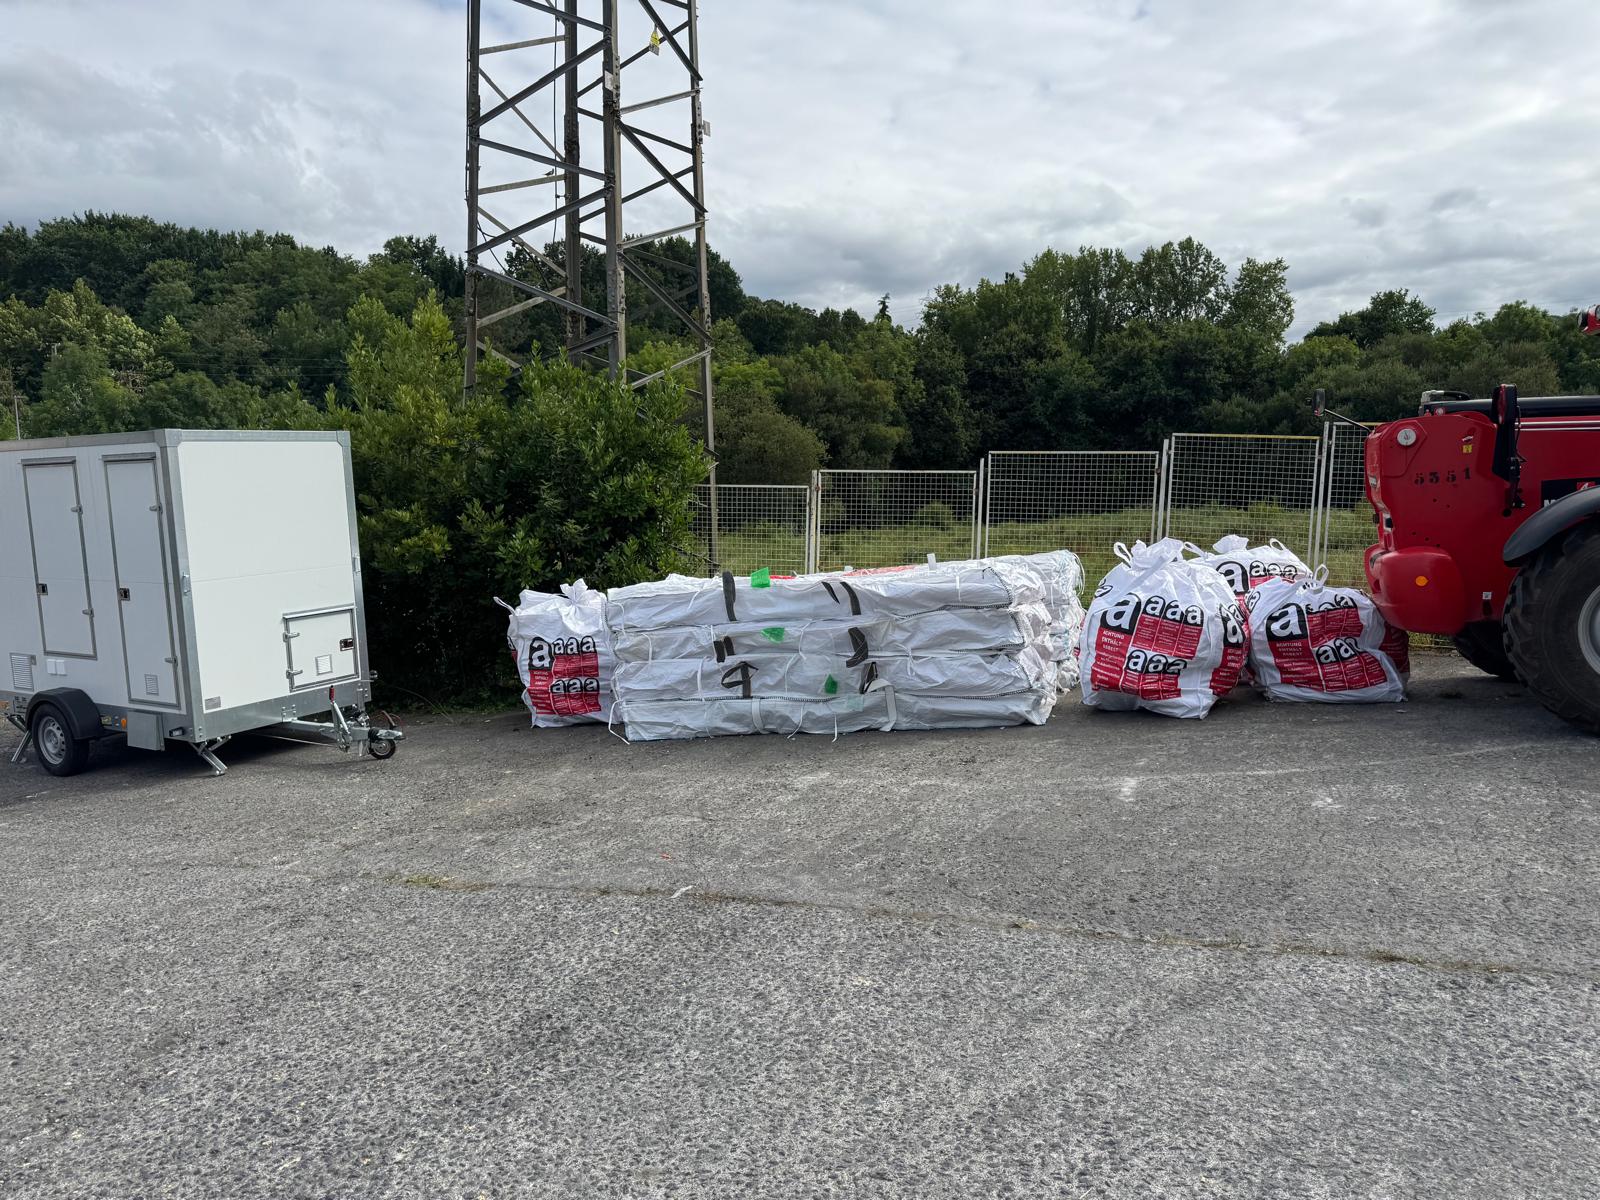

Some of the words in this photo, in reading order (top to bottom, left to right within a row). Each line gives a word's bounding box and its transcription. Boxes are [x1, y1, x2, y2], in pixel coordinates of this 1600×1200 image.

[1250, 561, 1265, 577] a
[1105, 594, 1138, 630] a
[1145, 596, 1164, 616] a
[1166, 601, 1182, 621] a
[1185, 605, 1202, 625] a
[1270, 605, 1302, 637] a
[531, 639, 550, 667] a
[552, 639, 564, 655] a
[567, 638, 578, 655] a
[582, 637, 595, 653] a
[1319, 645, 1338, 664] a
[1128, 651, 1145, 671] a
[1148, 654, 1166, 673] a
[568, 678, 580, 693] a
[585, 678, 597, 691] a
